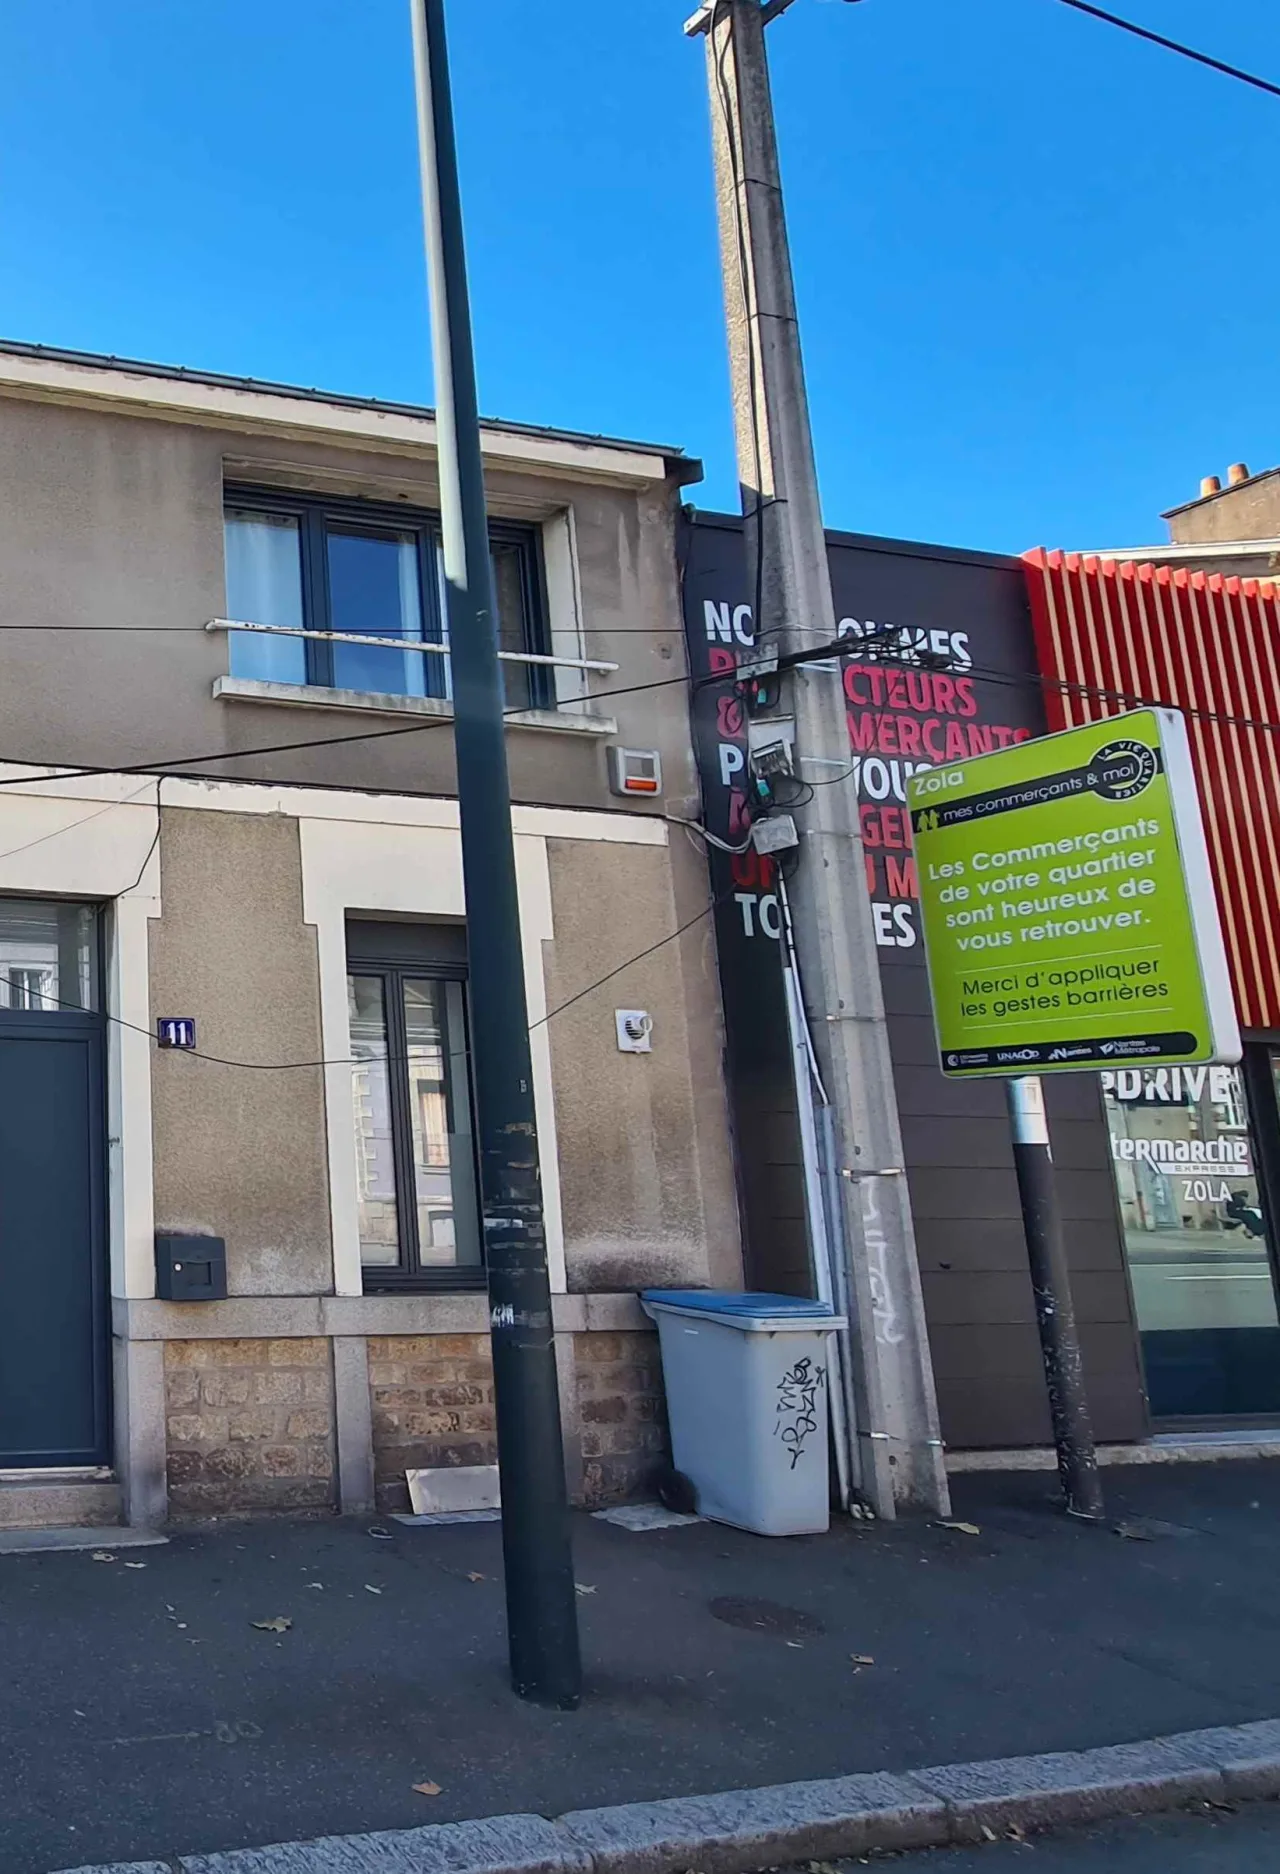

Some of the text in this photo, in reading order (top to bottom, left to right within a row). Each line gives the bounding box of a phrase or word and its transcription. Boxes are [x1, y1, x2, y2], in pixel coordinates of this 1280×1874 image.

[913, 769, 965, 797] Zola
[943, 762, 1135, 823] mes commerçants & moi
[928, 860, 965, 881] Les
[971, 818, 1160, 872] Commerçants
[939, 848, 1155, 904] de votre quartier
[946, 877, 1157, 928] sont heureux de
[956, 908, 1152, 951] vous retrouver.
[963, 959, 1160, 995] Merci d'appliquer
[961, 982, 1169, 1017] les gestes barrières
[167, 1022, 187, 1045] 11
[1111, 1132, 1249, 1166] termarché
[1174, 1164, 1236, 1173] EXPRESS
[1182, 1180, 1234, 1202] ZOLA
